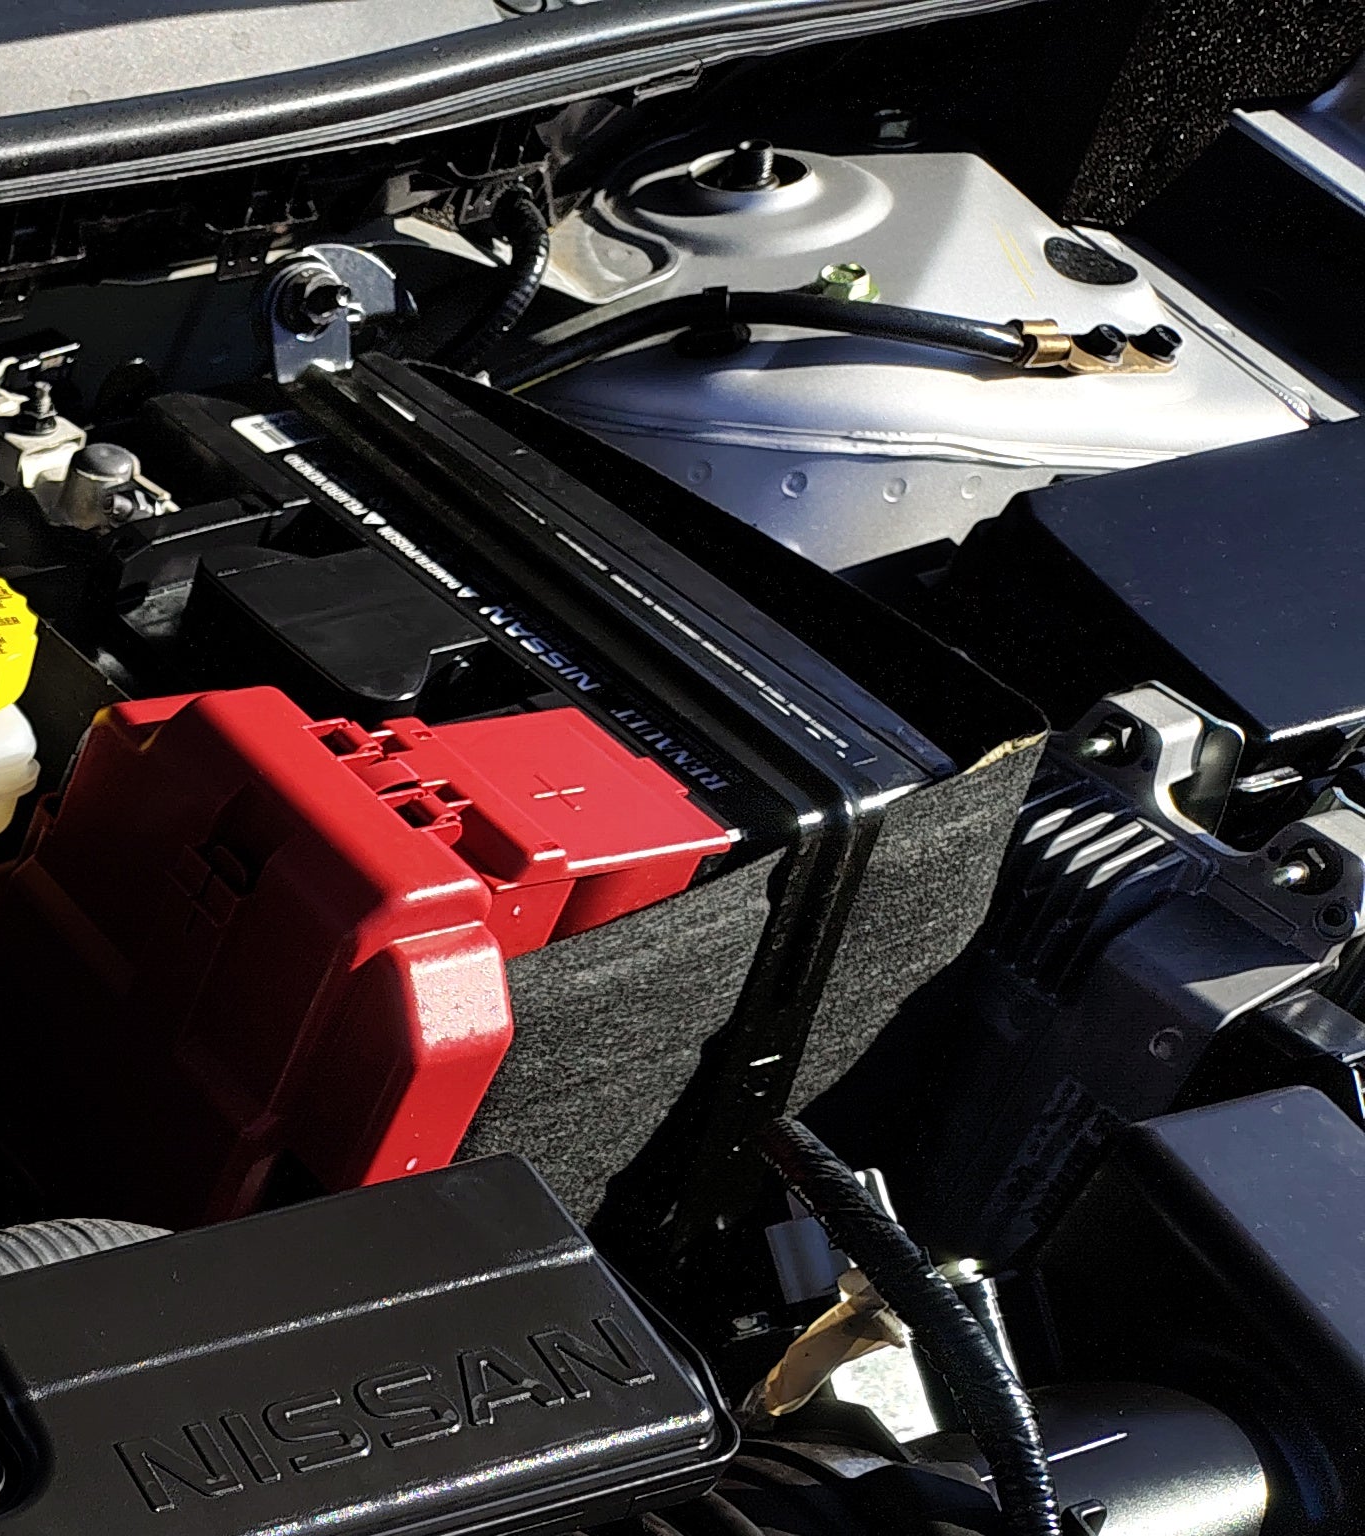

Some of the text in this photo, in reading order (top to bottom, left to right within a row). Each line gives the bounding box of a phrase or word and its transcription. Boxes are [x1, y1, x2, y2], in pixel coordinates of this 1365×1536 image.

[478, 603, 603, 693] NISSAN
[610, 706, 729, 792] RENAULT
[113, 1315, 660, 1514] NISSAN
